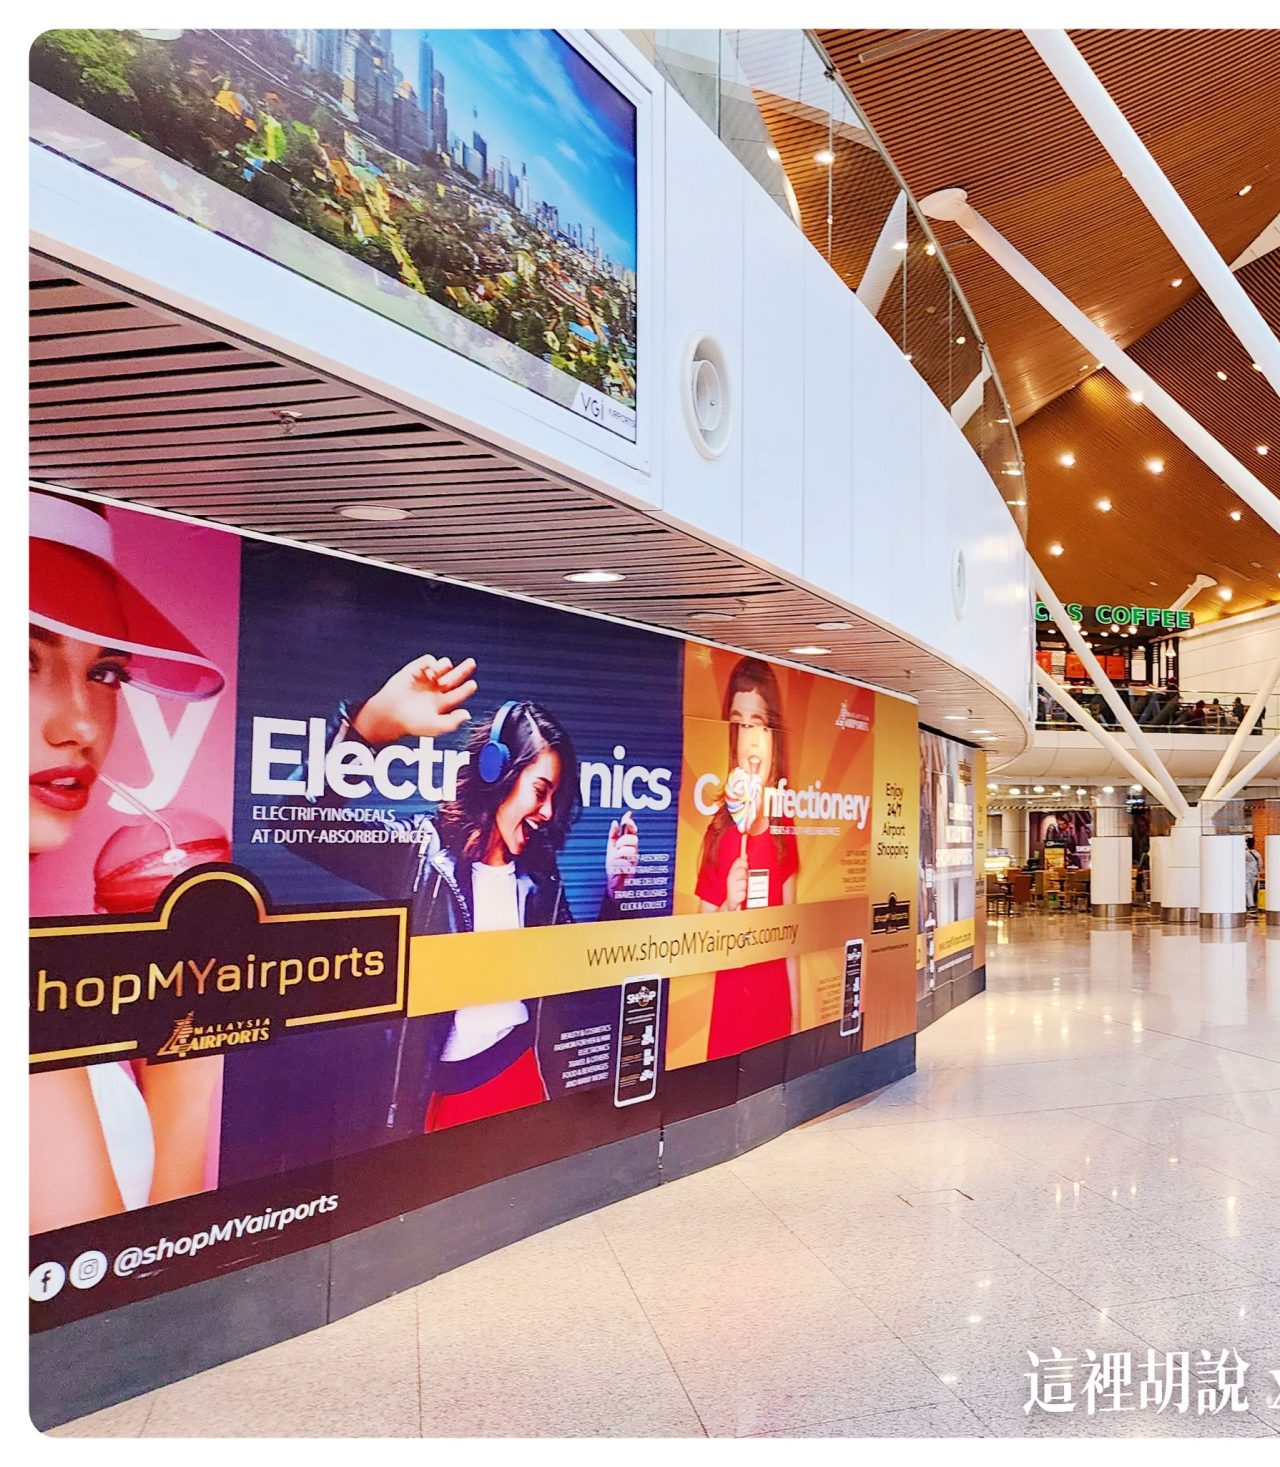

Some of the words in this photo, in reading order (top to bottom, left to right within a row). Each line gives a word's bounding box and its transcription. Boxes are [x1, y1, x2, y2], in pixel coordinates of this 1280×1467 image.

[1095, 604, 1191, 628] COFFEE
[251, 716, 671, 812] Electrnics
[886, 782, 904, 799] Enjoy
[693, 773, 871, 830] Cnfectionery
[253, 806, 351, 822] ELECTRIFYING
[354, 808, 397, 823] DEALS
[887, 804, 902, 817] 24/7
[252, 830, 271, 845] AT
[274, 829, 388, 845] DUTY-ABSORBED
[882, 823, 905, 838] Airport
[877, 842, 909, 858] Shopping
[36, 946, 385, 1015] hopMYairports
[194, 1017, 271, 1034] MALAYSIA
[188, 1028, 271, 1051] AIRPORTS
[113, 1194, 339, 1277] @shopMYairports
